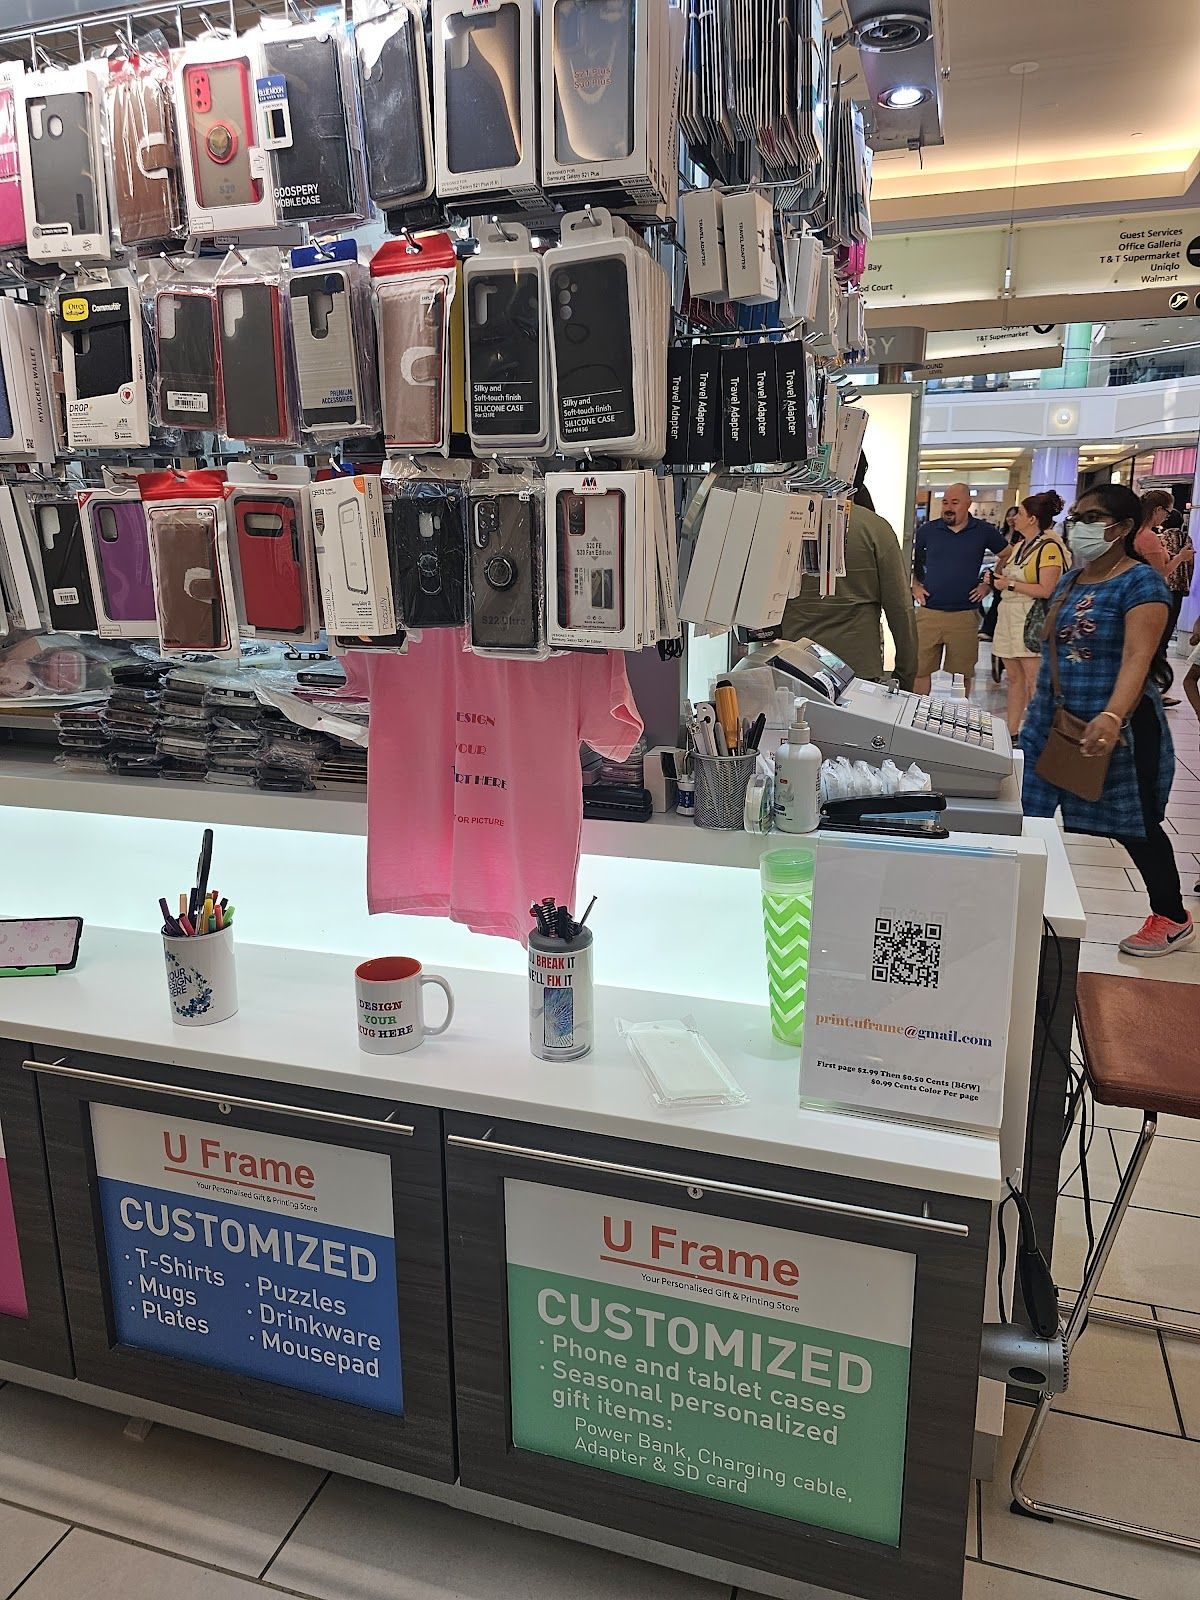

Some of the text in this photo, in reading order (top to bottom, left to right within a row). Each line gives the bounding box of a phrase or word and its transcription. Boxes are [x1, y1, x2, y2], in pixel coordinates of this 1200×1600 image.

[274, 184, 318, 198] GOOSPERY
[1120, 228, 1183, 240] Guest Services
[1118, 240, 1181, 251] Office Galleria
[1123, 251, 1180, 263] Supermarket
[868, 264, 882, 272] Bay
[1150, 263, 1180, 272] Uniqlo
[871, 284, 893, 292] Court
[1141, 274, 1178, 283] Walmart
[990, 331, 1029, 340] Supermarket
[30, 347, 38, 379] WALLET
[474, 385, 488, 393] Silky
[474, 394, 504, 402] Soft-touch
[563, 397, 591, 407] Silky and
[564, 404, 612, 417] Soft-touch finish
[669, 376, 682, 440] Travel Adapter
[695, 372, 709, 436] Travel Adapter
[729, 377, 740, 442] Travel Adapter
[756, 370, 768, 436] Travel Adapter
[785, 369, 798, 436] Travel Adapter
[565, 415, 615, 428] SILICONE CASE
[482, 615, 527, 625] S22 Ultra
[456, 712, 496, 727] ESIGN
[455, 743, 487, 755] OUR
[475, 775, 508, 791] HERE
[457, 816, 505, 827] OR PICTURE
[536, 954, 576, 969] BREAK IT
[168, 975, 193, 990] ESIGN
[547, 974, 561, 987] FIX
[564, 974, 573, 986] IT
[359, 999, 403, 1012] DESIGN
[363, 1014, 397, 1025] YOUR
[377, 1024, 414, 1039] HERE
[817, 1060, 981, 1093] First page $2.99 Then $0.50 Cents [B&W]
[870, 1078, 979, 1102] $0.99 Cents Color Per page
[162, 1131, 316, 1189] U Frame
[196, 1181, 211, 1191] Your
[212, 1185, 253, 1199] Personalised
[253, 1193, 266, 1202] Gift
[273, 1197, 299, 1210] Printing
[300, 1202, 318, 1213] Store
[120, 1196, 377, 1284] CUSTOMIZED
[602, 1215, 800, 1288] U Frame
[135, 1248, 226, 1287] T-Shirts
[139, 1274, 197, 1309] Mugs
[257, 1276, 347, 1316] Puzzles
[641, 1272, 800, 1313] Your Personalised Gift & Printing Store
[142, 1299, 210, 1334] Plates
[260, 1303, 382, 1352] Drinkware
[537, 1287, 873, 1394] CUSTOMIZED
[262, 1330, 380, 1378] Mousepad
[553, 1334, 847, 1421] Phone and tablet cases
[552, 1360, 838, 1446] Seasonal personalized
[552, 1387, 673, 1432] gift items:
[575, 1417, 853, 1503] Power Bank, Charging cable,
[575, 1436, 748, 1494] Adapter & SD card
